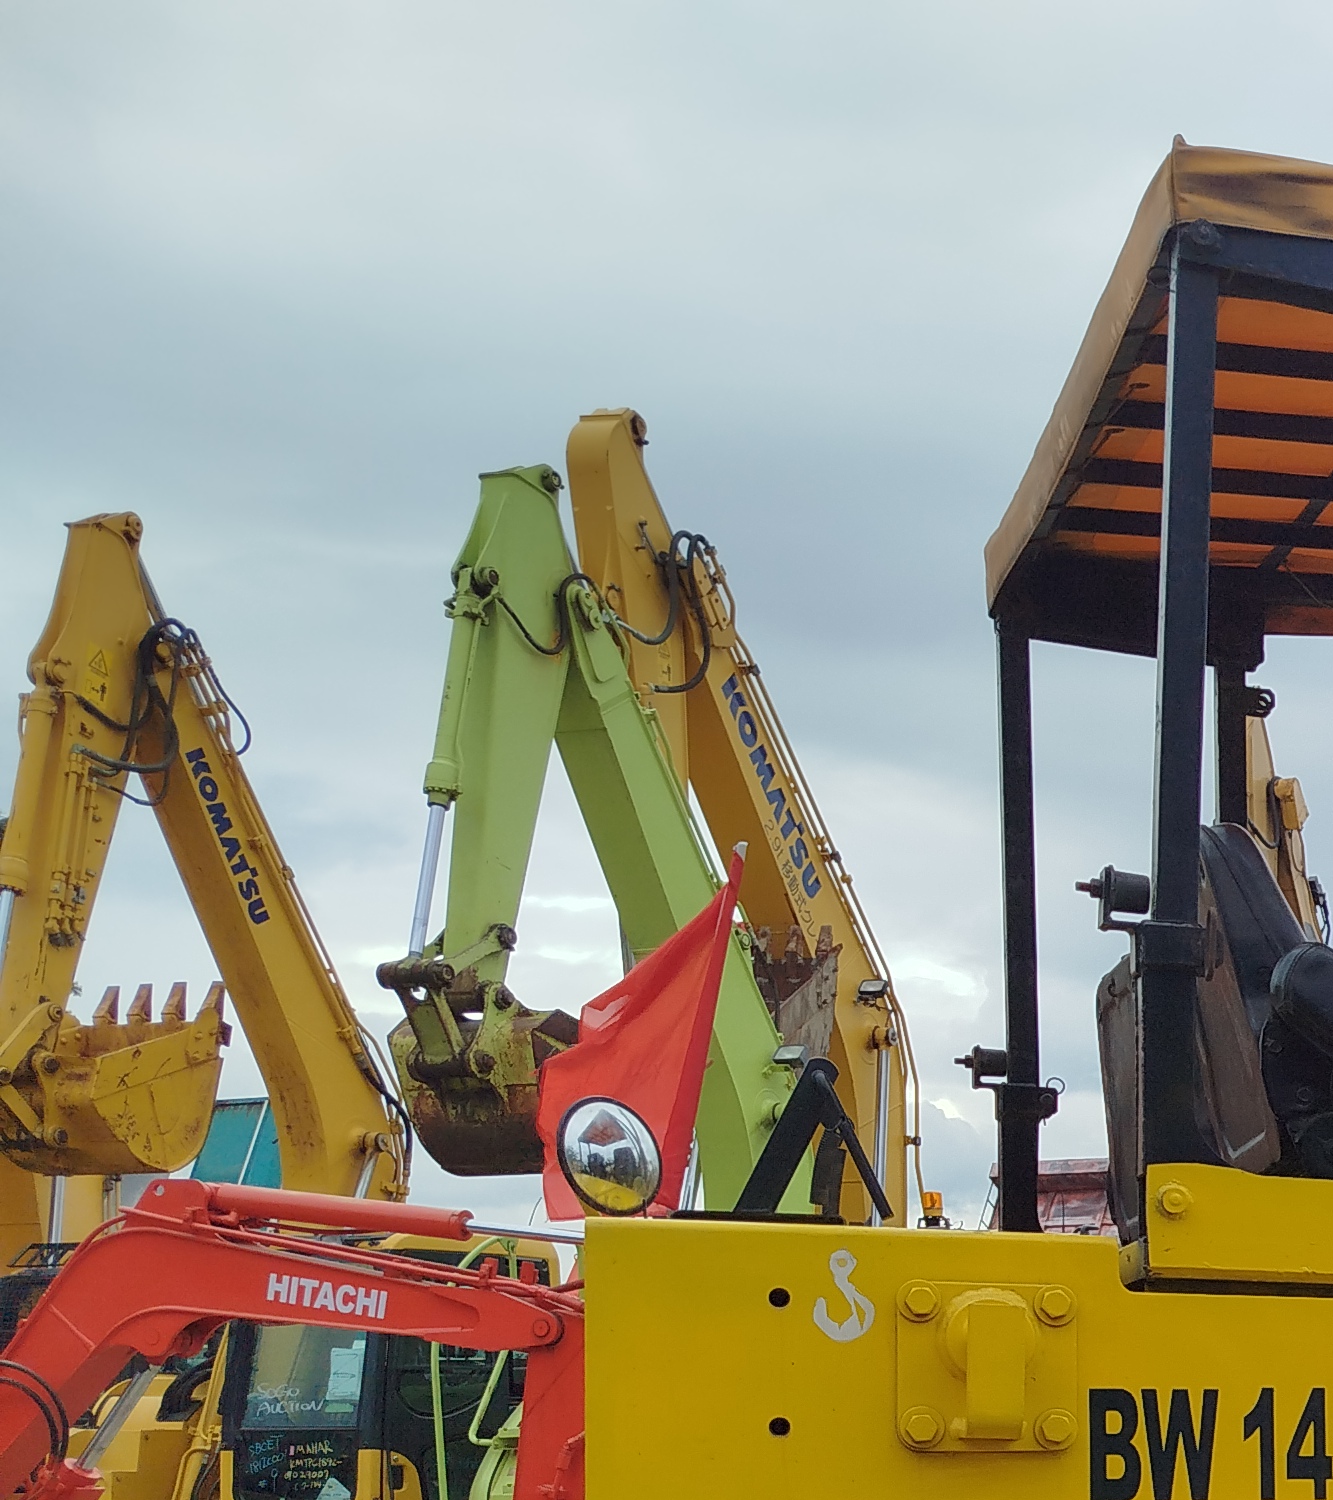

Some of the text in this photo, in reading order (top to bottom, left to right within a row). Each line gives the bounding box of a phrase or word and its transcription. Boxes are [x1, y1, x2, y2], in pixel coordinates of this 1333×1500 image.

[185, 747, 270, 925] KOMATSU
[721, 672, 822, 898] KOMATSU
[266, 1272, 388, 1319] HITACHI
[257, 1400, 324, 1417] AUCTION
